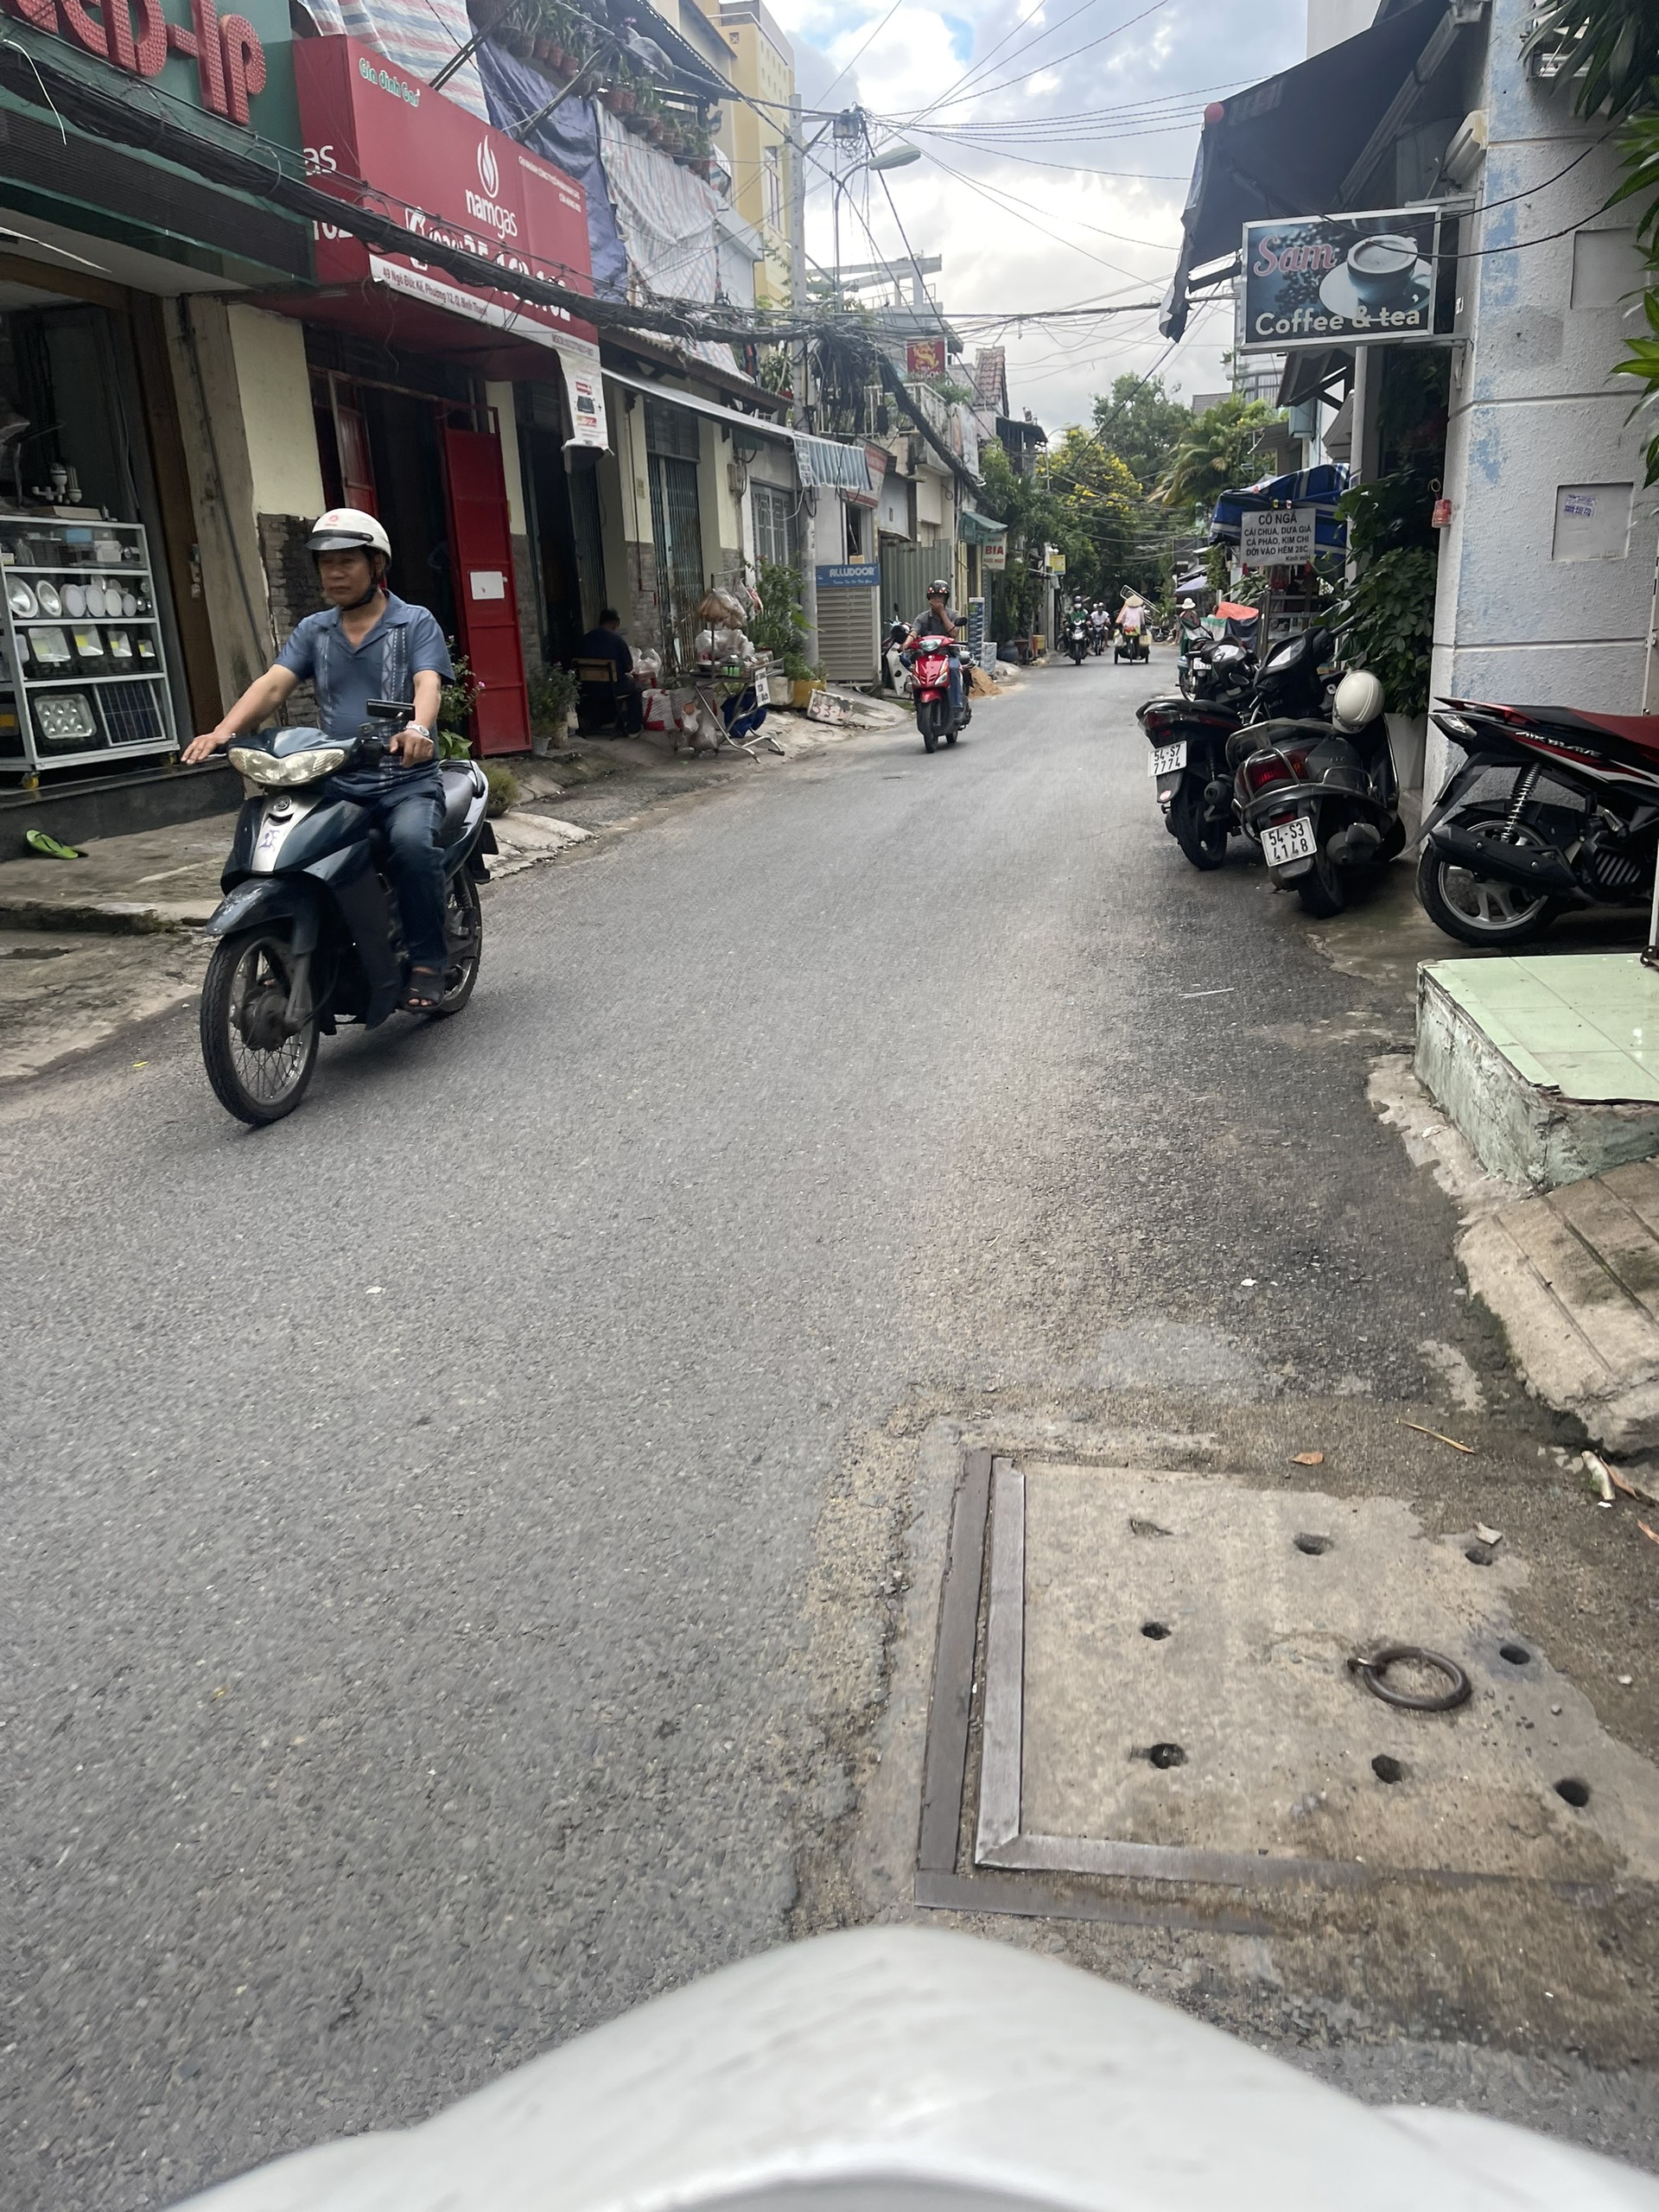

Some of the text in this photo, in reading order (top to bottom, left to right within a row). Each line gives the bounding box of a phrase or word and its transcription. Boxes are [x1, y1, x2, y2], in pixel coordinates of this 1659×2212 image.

[465, 188, 518, 239] namgas
[1253, 235, 1338, 276] Sam
[1255, 305, 1420, 335] Coffee & tea
[985, 545, 1004, 555] BIA
[1296, 535, 1309, 543] CHI
[1154, 744, 1180, 761] 54-S7
[1154, 757, 1180, 773] 7774
[1268, 823, 1304, 845] 54-S3
[1274, 838, 1308, 861] 4148
